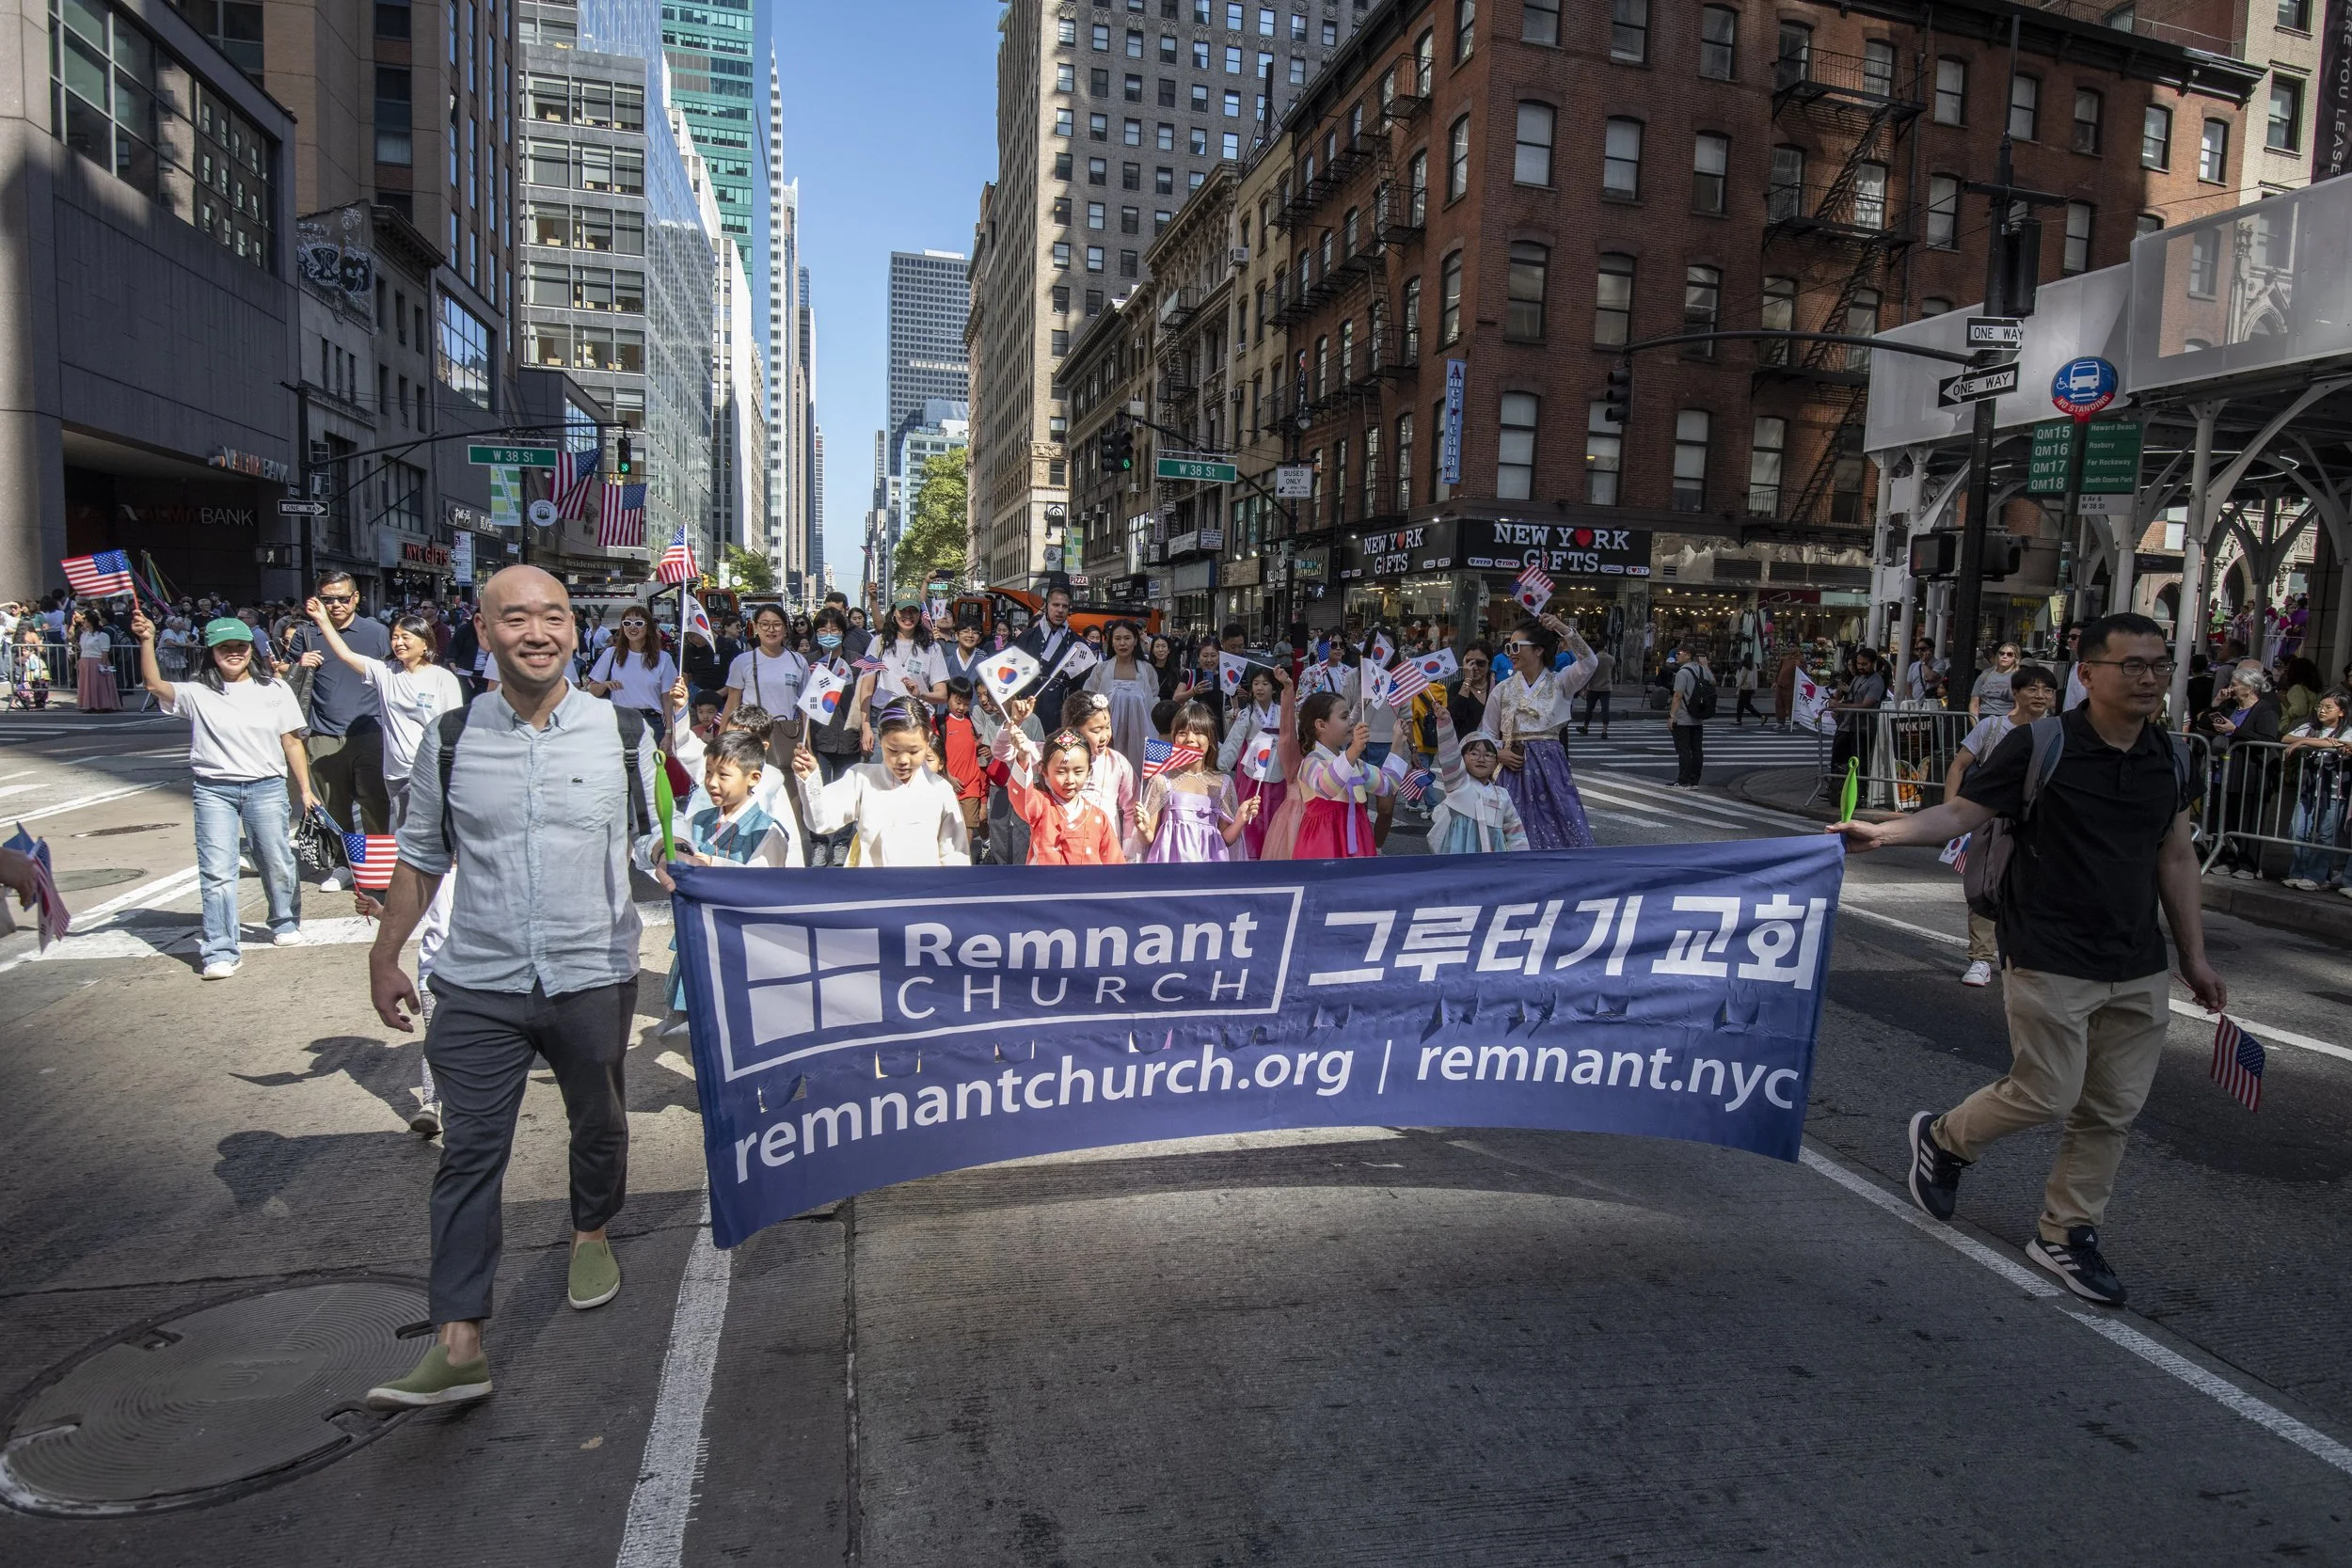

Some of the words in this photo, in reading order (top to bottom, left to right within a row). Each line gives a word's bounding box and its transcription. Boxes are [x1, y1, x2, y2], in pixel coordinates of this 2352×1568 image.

[2338, 57, 2350, 99] YOU
[2330, 108, 2346, 174] LEASE
[1974, 326, 1994, 340] ONE
[2003, 327, 2024, 341] WAY
[1952, 381, 1975, 396] ONE
[1985, 373, 2010, 389] WAY
[2058, 398, 2069, 408] NO
[2068, 395, 2109, 412] STANDING
[2036, 425, 2070, 439] QM15
[493, 451, 501, 461] W
[505, 451, 519, 462] 38
[523, 451, 534, 463] St
[2035, 443, 2068, 456] QM16
[1179, 464, 1188, 474] W
[1190, 465, 1202, 476] 38
[1205, 466, 1216, 477] St
[2033, 460, 2066, 473] QM17
[2030, 477, 2064, 491] QM18
[285, 503, 300, 512] ONE
[306, 504, 322, 513] WAY
[1493, 522, 1551, 546] NEW
[406, 543, 422, 562] NYC
[426, 546, 449, 565] GIFTS
[1364, 535, 1387, 556] NEW
[565, 558, 601, 570] Residence
[1070, 577, 1088, 585] PIZZA
[904, 911, 1259, 970] Remnant
[1308, 895, 1644, 986] 그루터기
[1651, 894, 1827, 990] 교회
[898, 968, 1248, 1020] CHURCH
[734, 1042, 1354, 1184] remnantchurch.org
[1417, 1045, 1800, 1112] remnant.nyc
